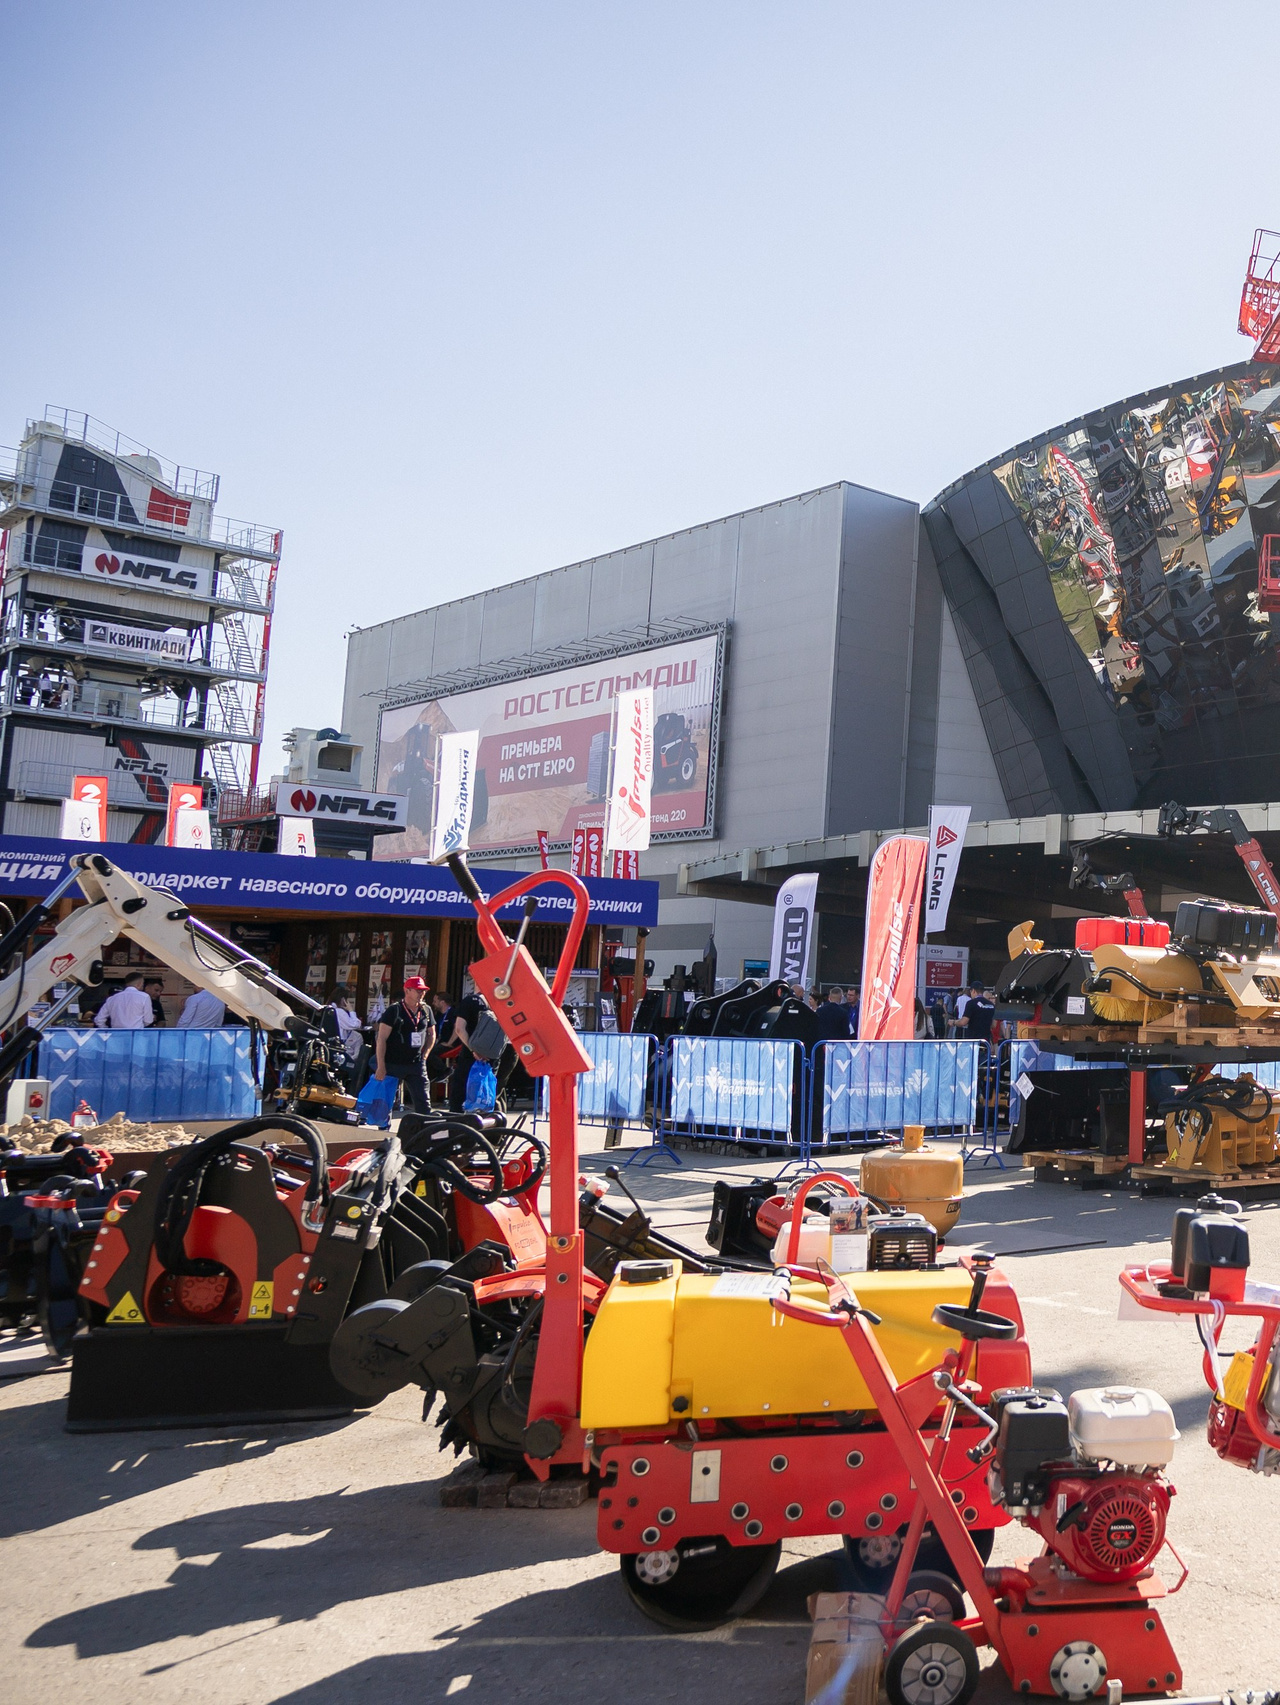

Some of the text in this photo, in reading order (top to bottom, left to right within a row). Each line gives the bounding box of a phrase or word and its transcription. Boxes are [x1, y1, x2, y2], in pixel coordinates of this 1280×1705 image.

[121, 559, 198, 590] NFLG
[109, 631, 186, 657] КВИНТМАДИ
[504, 659, 698, 720] РОСТСЕЛЬМАШ
[501, 735, 562, 761] ПРЕМЬЕРА
[114, 757, 169, 777] NFLG
[499, 765, 515, 784] НА
[543, 757, 576, 777] EXPO
[317, 794, 397, 821] NFLG
[670, 809, 687, 822] 220
[239, 877, 347, 897] навесного
[538, 896, 643, 913] спецехники
[1110, 1530, 1134, 1540] GX
